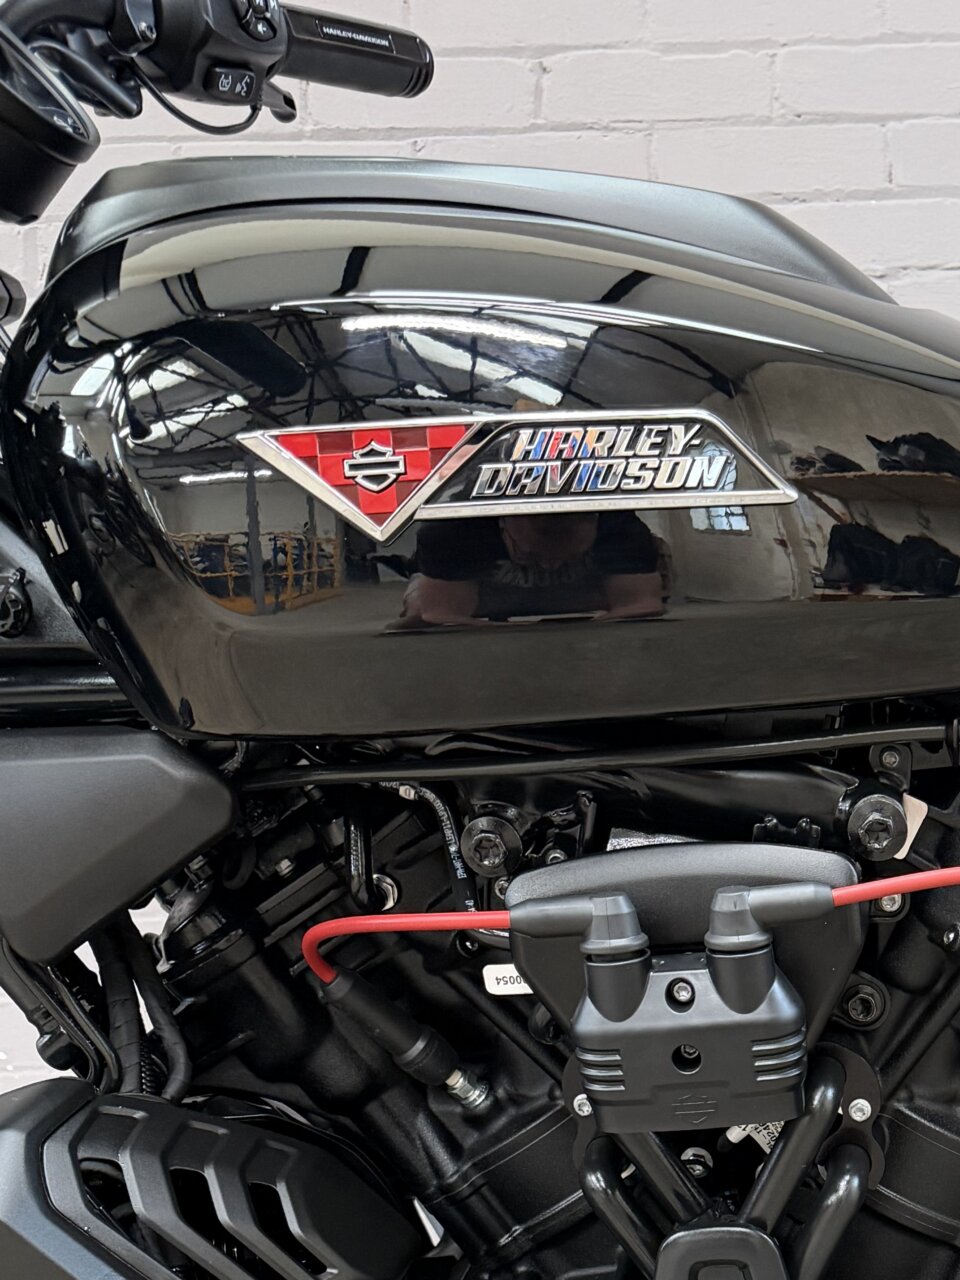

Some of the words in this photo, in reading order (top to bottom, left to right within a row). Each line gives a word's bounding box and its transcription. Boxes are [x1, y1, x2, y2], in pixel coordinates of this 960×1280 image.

[511, 423, 702, 461] HARLEY-
[472, 455, 730, 498] DAVIDSON
[495, 975, 526, 986] 0054
